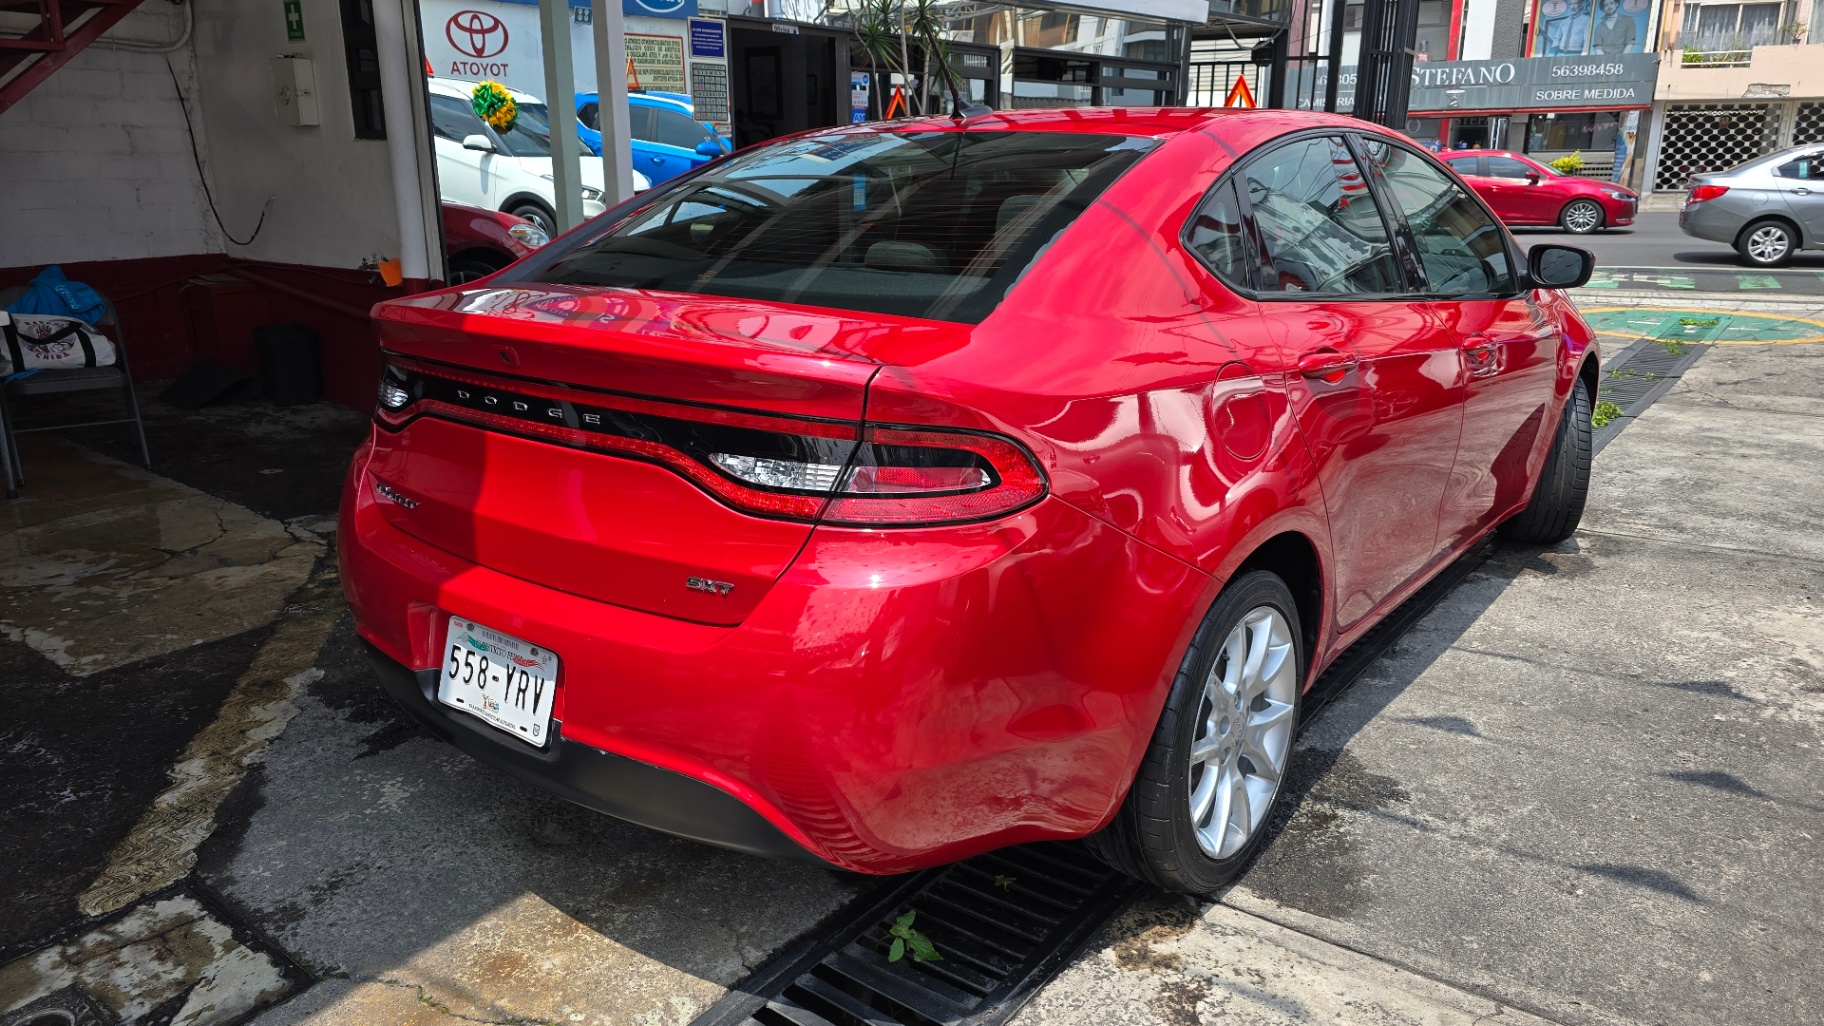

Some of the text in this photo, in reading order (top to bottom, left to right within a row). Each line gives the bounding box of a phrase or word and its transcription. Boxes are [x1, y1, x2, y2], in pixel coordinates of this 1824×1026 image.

[1411, 62, 1515, 86] STEFANO
[1552, 63, 1624, 78] 56398458
[1536, 88, 1635, 101] SOBRE MEDIDA
[35, 352, 71, 361] CHIBA
[457, 389, 601, 425] DODGE
[686, 576, 735, 595] SXT
[448, 643, 545, 716] 558-YRV
